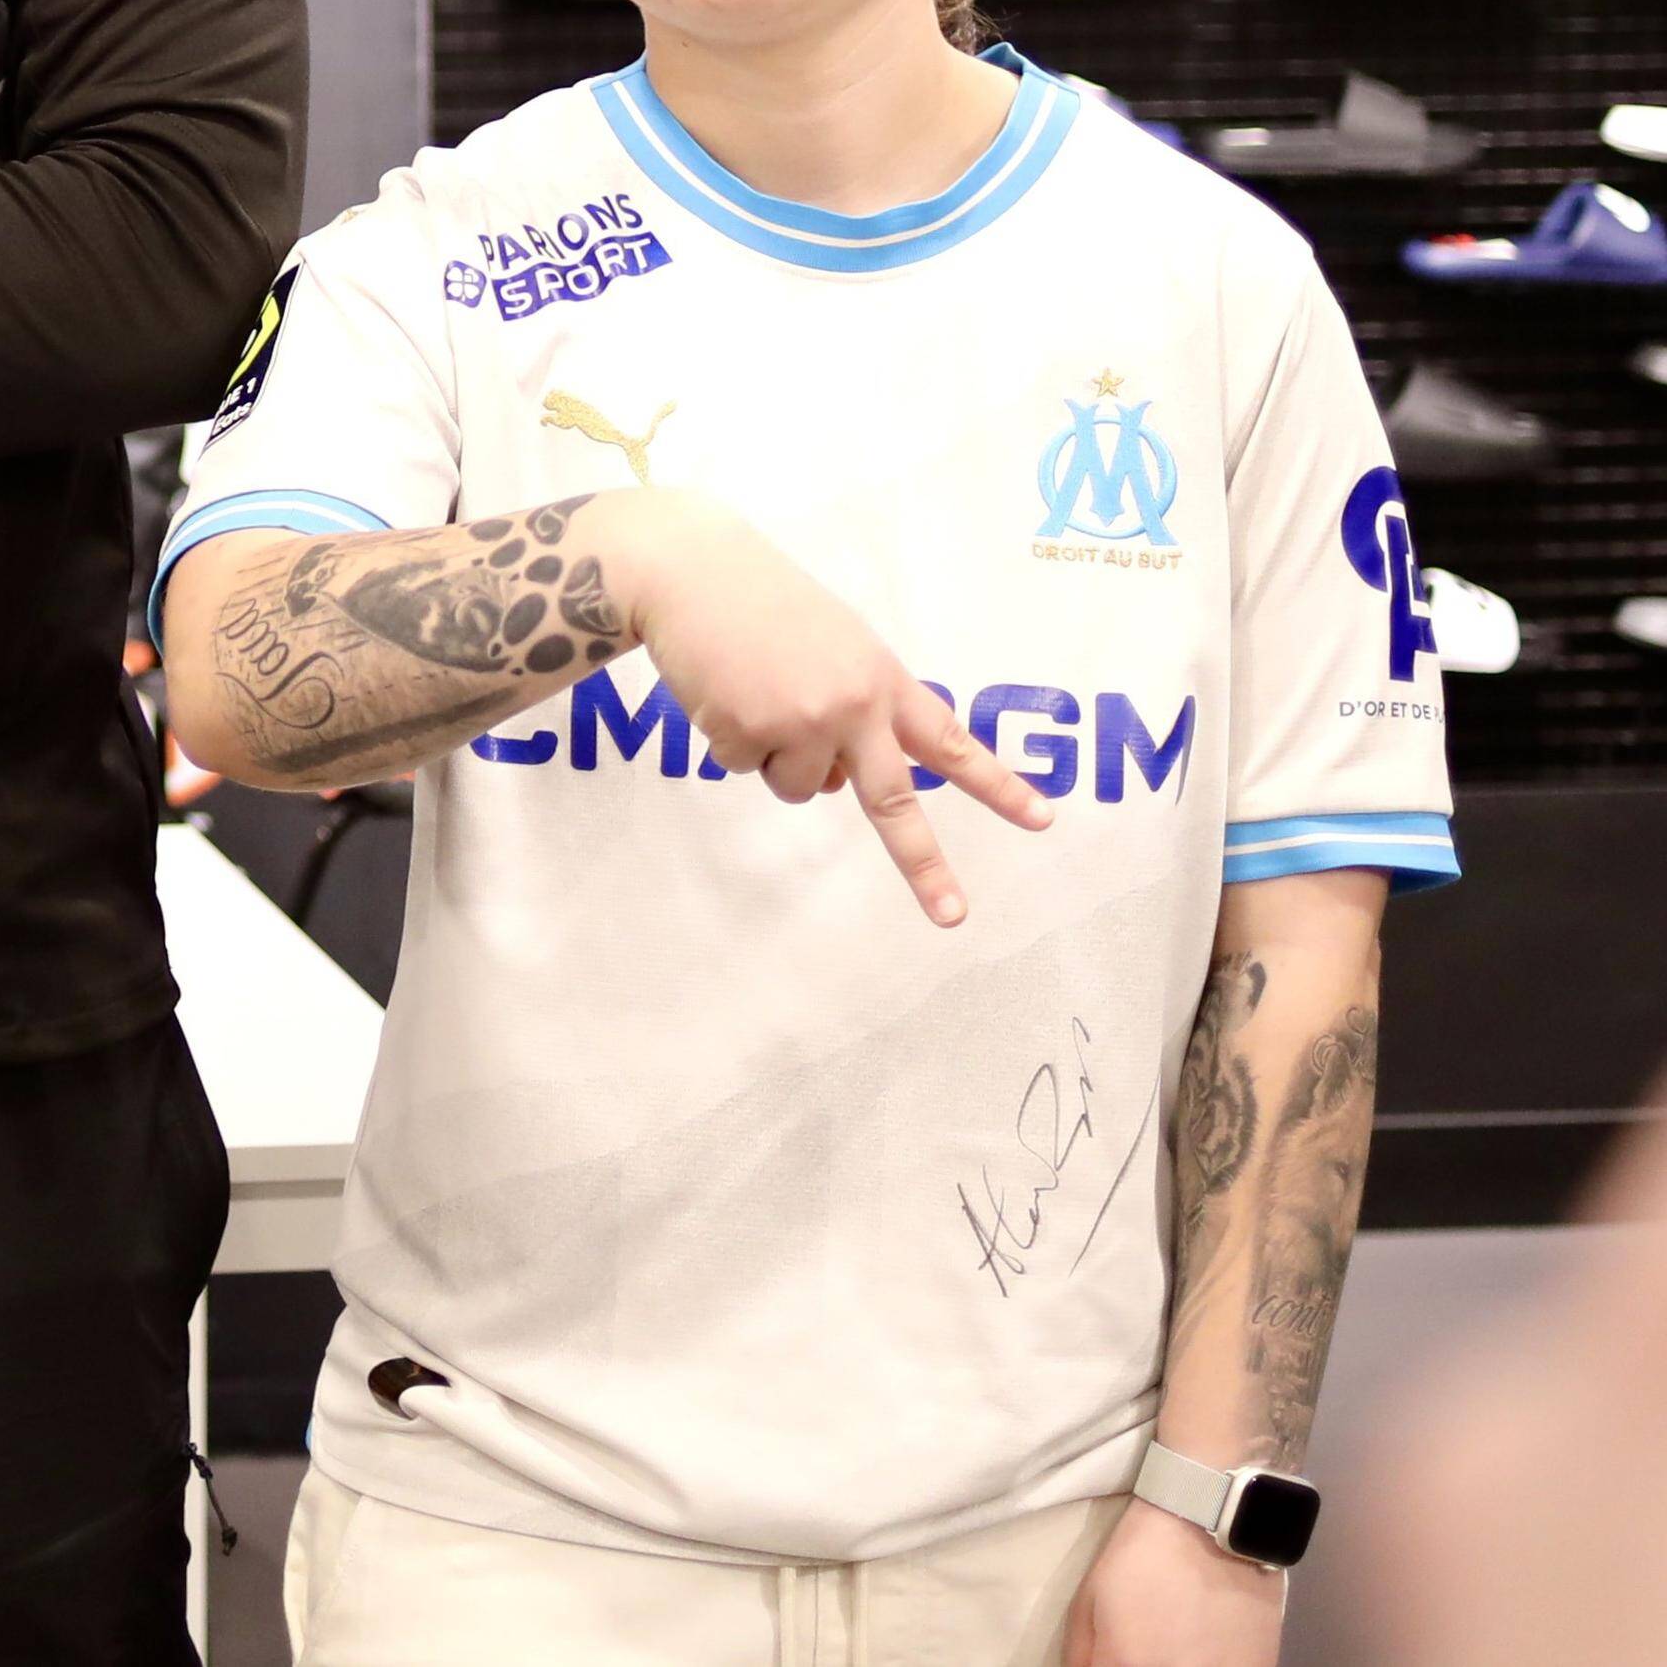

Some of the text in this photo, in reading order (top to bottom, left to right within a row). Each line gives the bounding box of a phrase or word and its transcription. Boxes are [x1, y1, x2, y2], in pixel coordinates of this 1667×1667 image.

[478, 193, 643, 272] PARIONS
[499, 237, 653, 315] SPORT
[1031, 542, 1184, 571] DROIT AU BUT
[907, 679, 1197, 807] GM
[1338, 700, 1386, 718] D'OR
[1390, 701, 1408, 719] ET
[1411, 703, 1432, 721] DE
